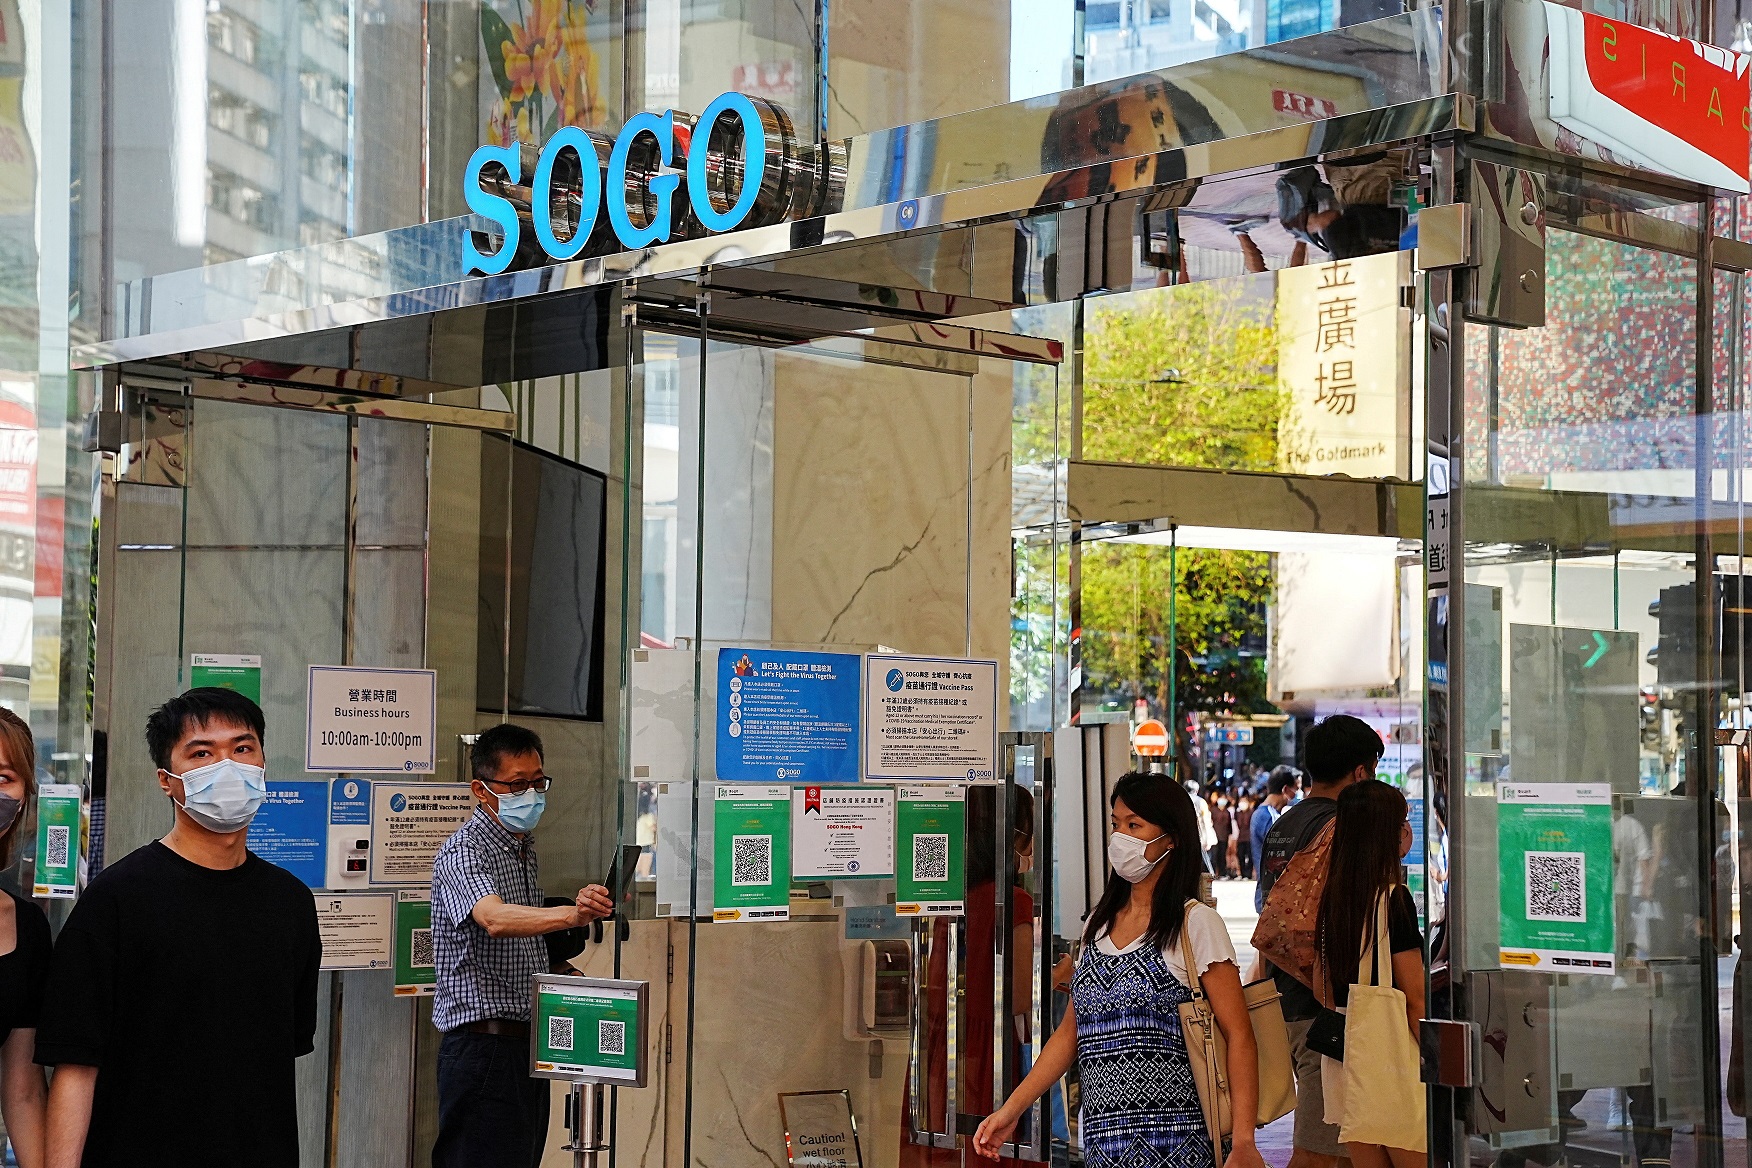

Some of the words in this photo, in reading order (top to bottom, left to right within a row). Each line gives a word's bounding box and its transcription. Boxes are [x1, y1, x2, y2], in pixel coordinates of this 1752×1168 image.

[462, 91, 765, 276] SOGO
[1316, 442, 1386, 463] Goldmark
[348, 688, 397, 703] 營業時間
[334, 707, 379, 718] Business
[382, 708, 410, 718] hours
[321, 730, 422, 750] 10:00am-10:00pm
[799, 1132, 845, 1145] Caution!
[803, 1149, 821, 1158] wet
[822, 1148, 846, 1156] floor
